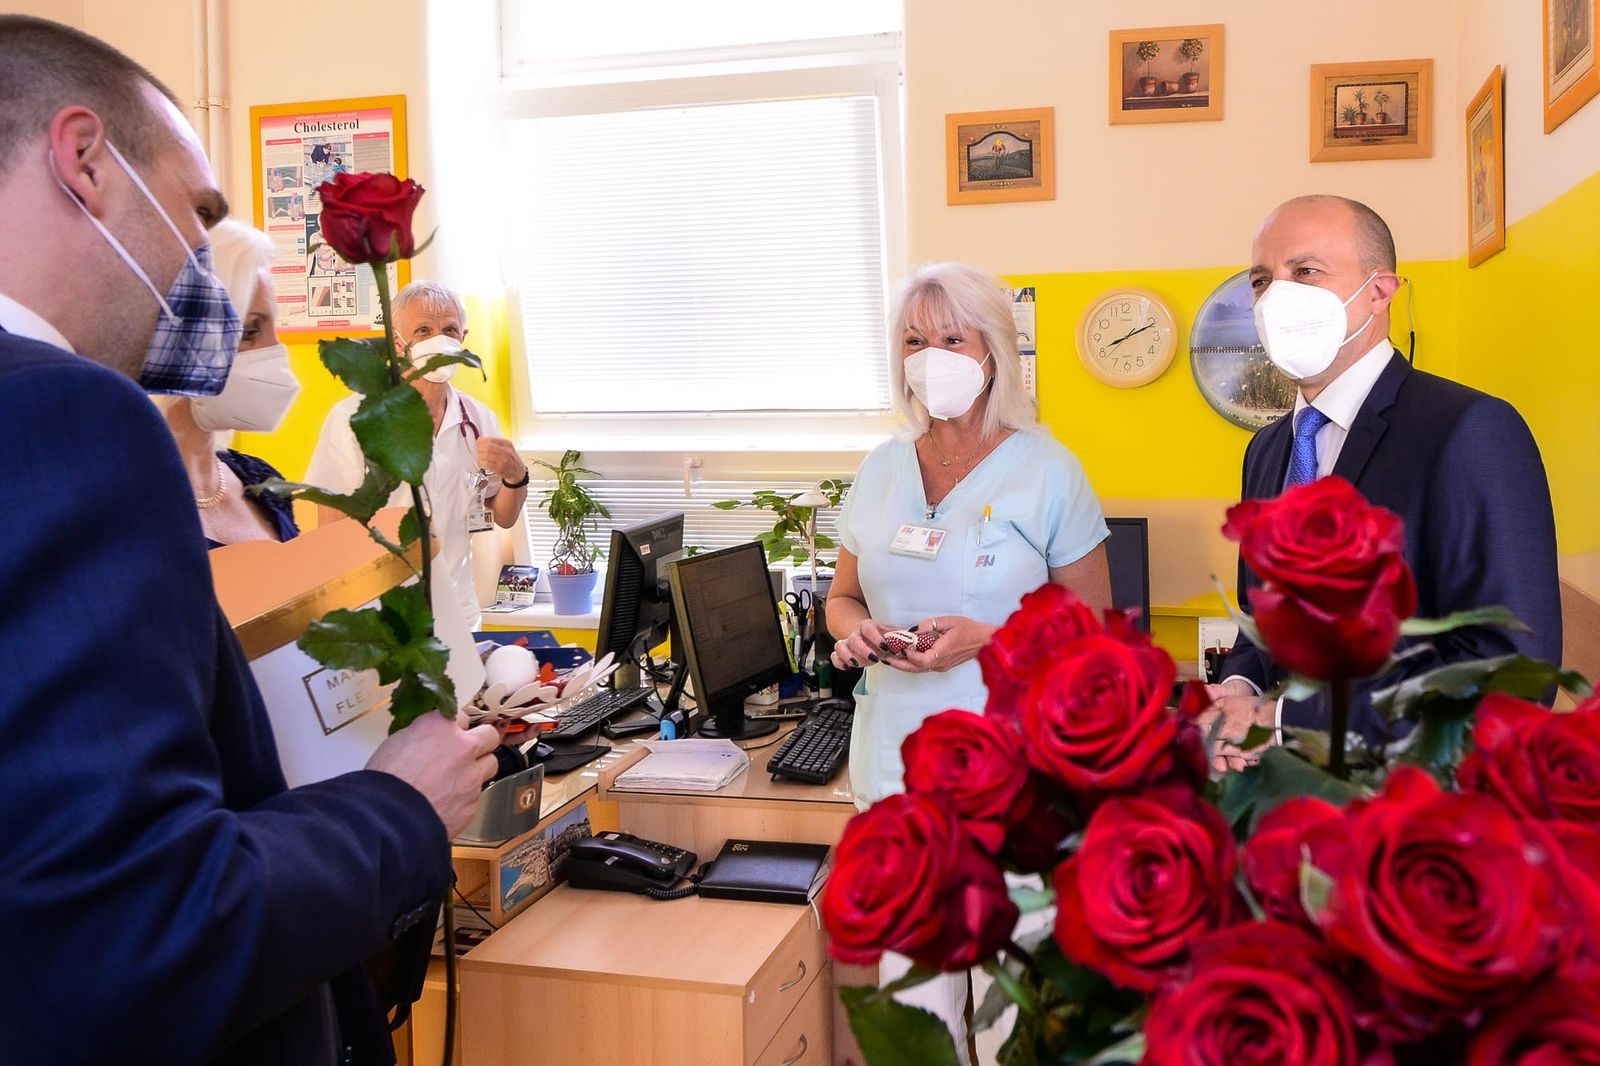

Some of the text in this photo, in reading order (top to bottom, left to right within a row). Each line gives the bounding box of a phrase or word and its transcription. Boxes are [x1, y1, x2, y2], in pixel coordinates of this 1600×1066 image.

[294, 118, 359, 133] Cholesterol
[1110, 306, 1118, 318] 11
[1121, 302, 1131, 314] 12
[1099, 319, 1111, 330] 10
[1093, 332, 1102, 344] 9
[1153, 330, 1160, 342] 3
[1099, 348, 1107, 358] 8
[1148, 344, 1155, 354] 4
[1112, 358, 1119, 368] 7
[1123, 361, 1132, 371] 6
[1136, 356, 1144, 368] 5
